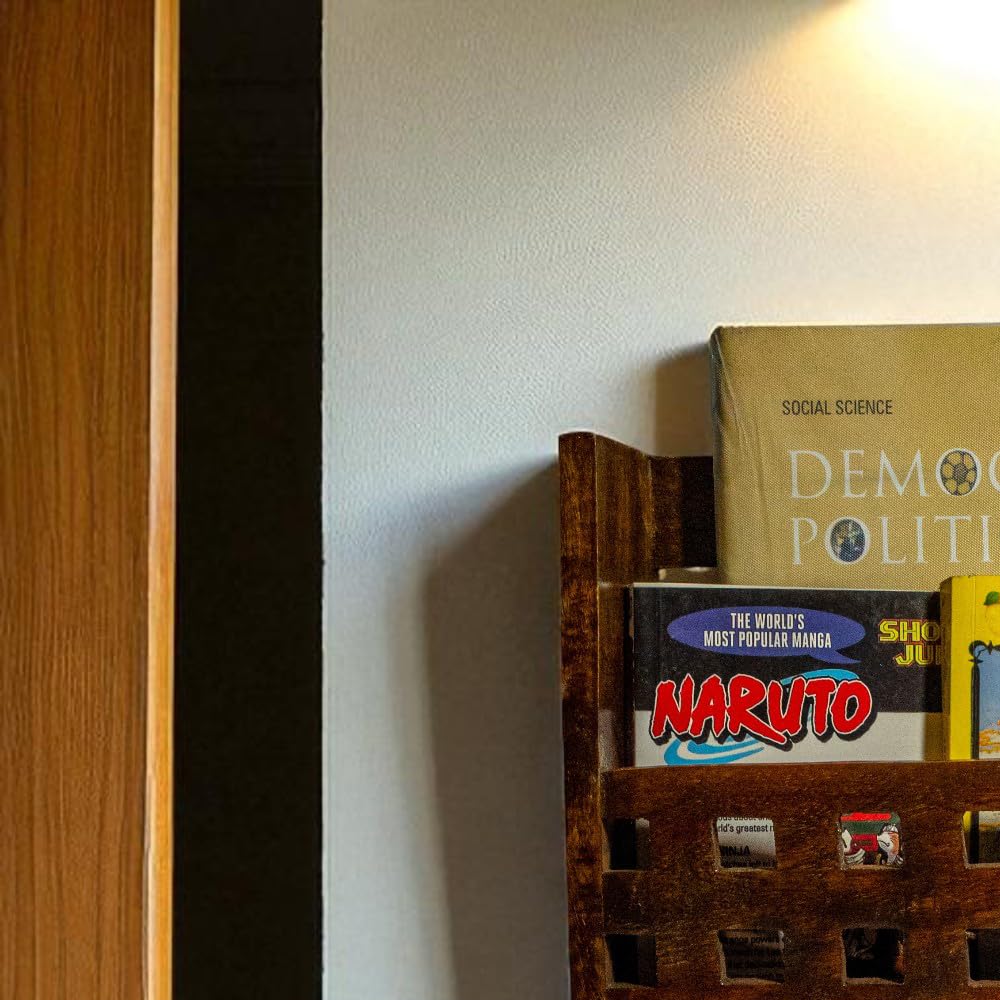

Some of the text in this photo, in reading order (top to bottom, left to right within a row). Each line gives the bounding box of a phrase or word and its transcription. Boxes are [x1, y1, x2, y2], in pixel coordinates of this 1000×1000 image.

[782, 399, 893, 416] SOCIAL SCIENCE
[730, 612, 805, 630] THE WORLD'S
[703, 630, 832, 649] MOST POPULAR MANGA
[650, 672, 874, 748] NARUTO
[736, 823, 769, 835] greatest
